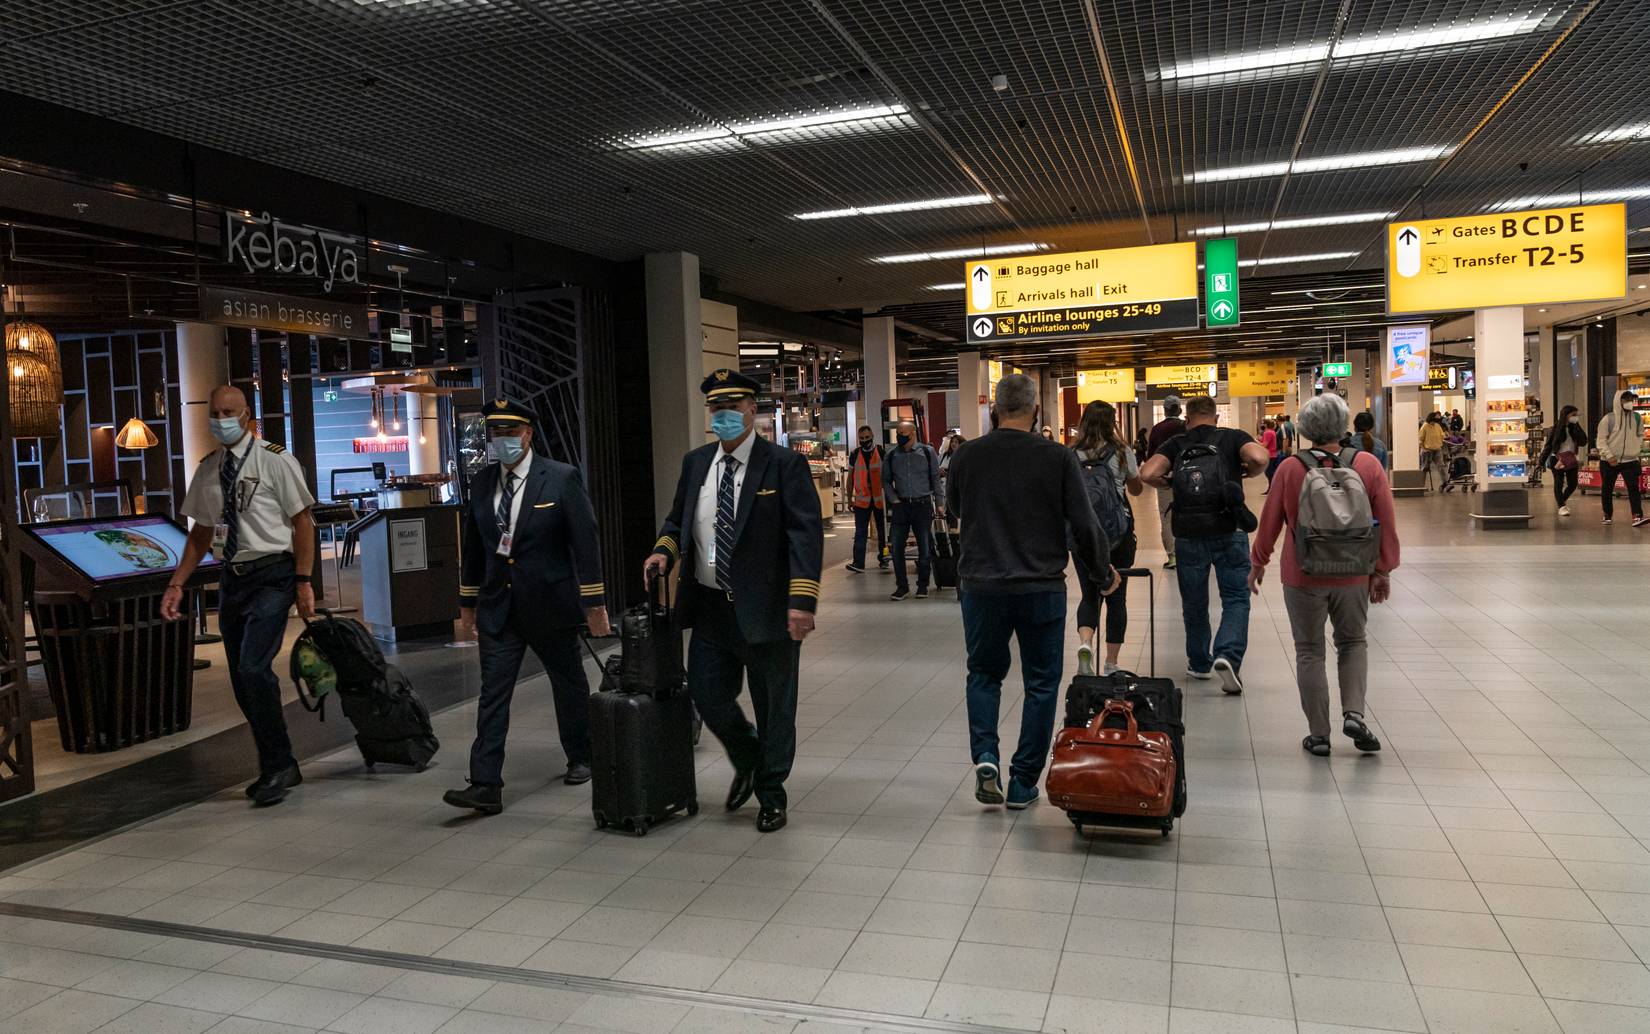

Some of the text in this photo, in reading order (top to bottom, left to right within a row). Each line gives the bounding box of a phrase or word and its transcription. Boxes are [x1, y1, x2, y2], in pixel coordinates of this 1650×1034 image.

[1452, 225, 1496, 238] Gates
[1453, 243, 1585, 268] Transfer T2-5
[1017, 258, 1099, 276] Baggage hall
[1017, 286, 1093, 303] Arrivals hall
[1103, 284, 1128, 296] Exit
[223, 297, 352, 330] asian brasserie
[1018, 303, 1162, 325] Airline lounges 25-49
[1018, 322, 1090, 336] By invitation only
